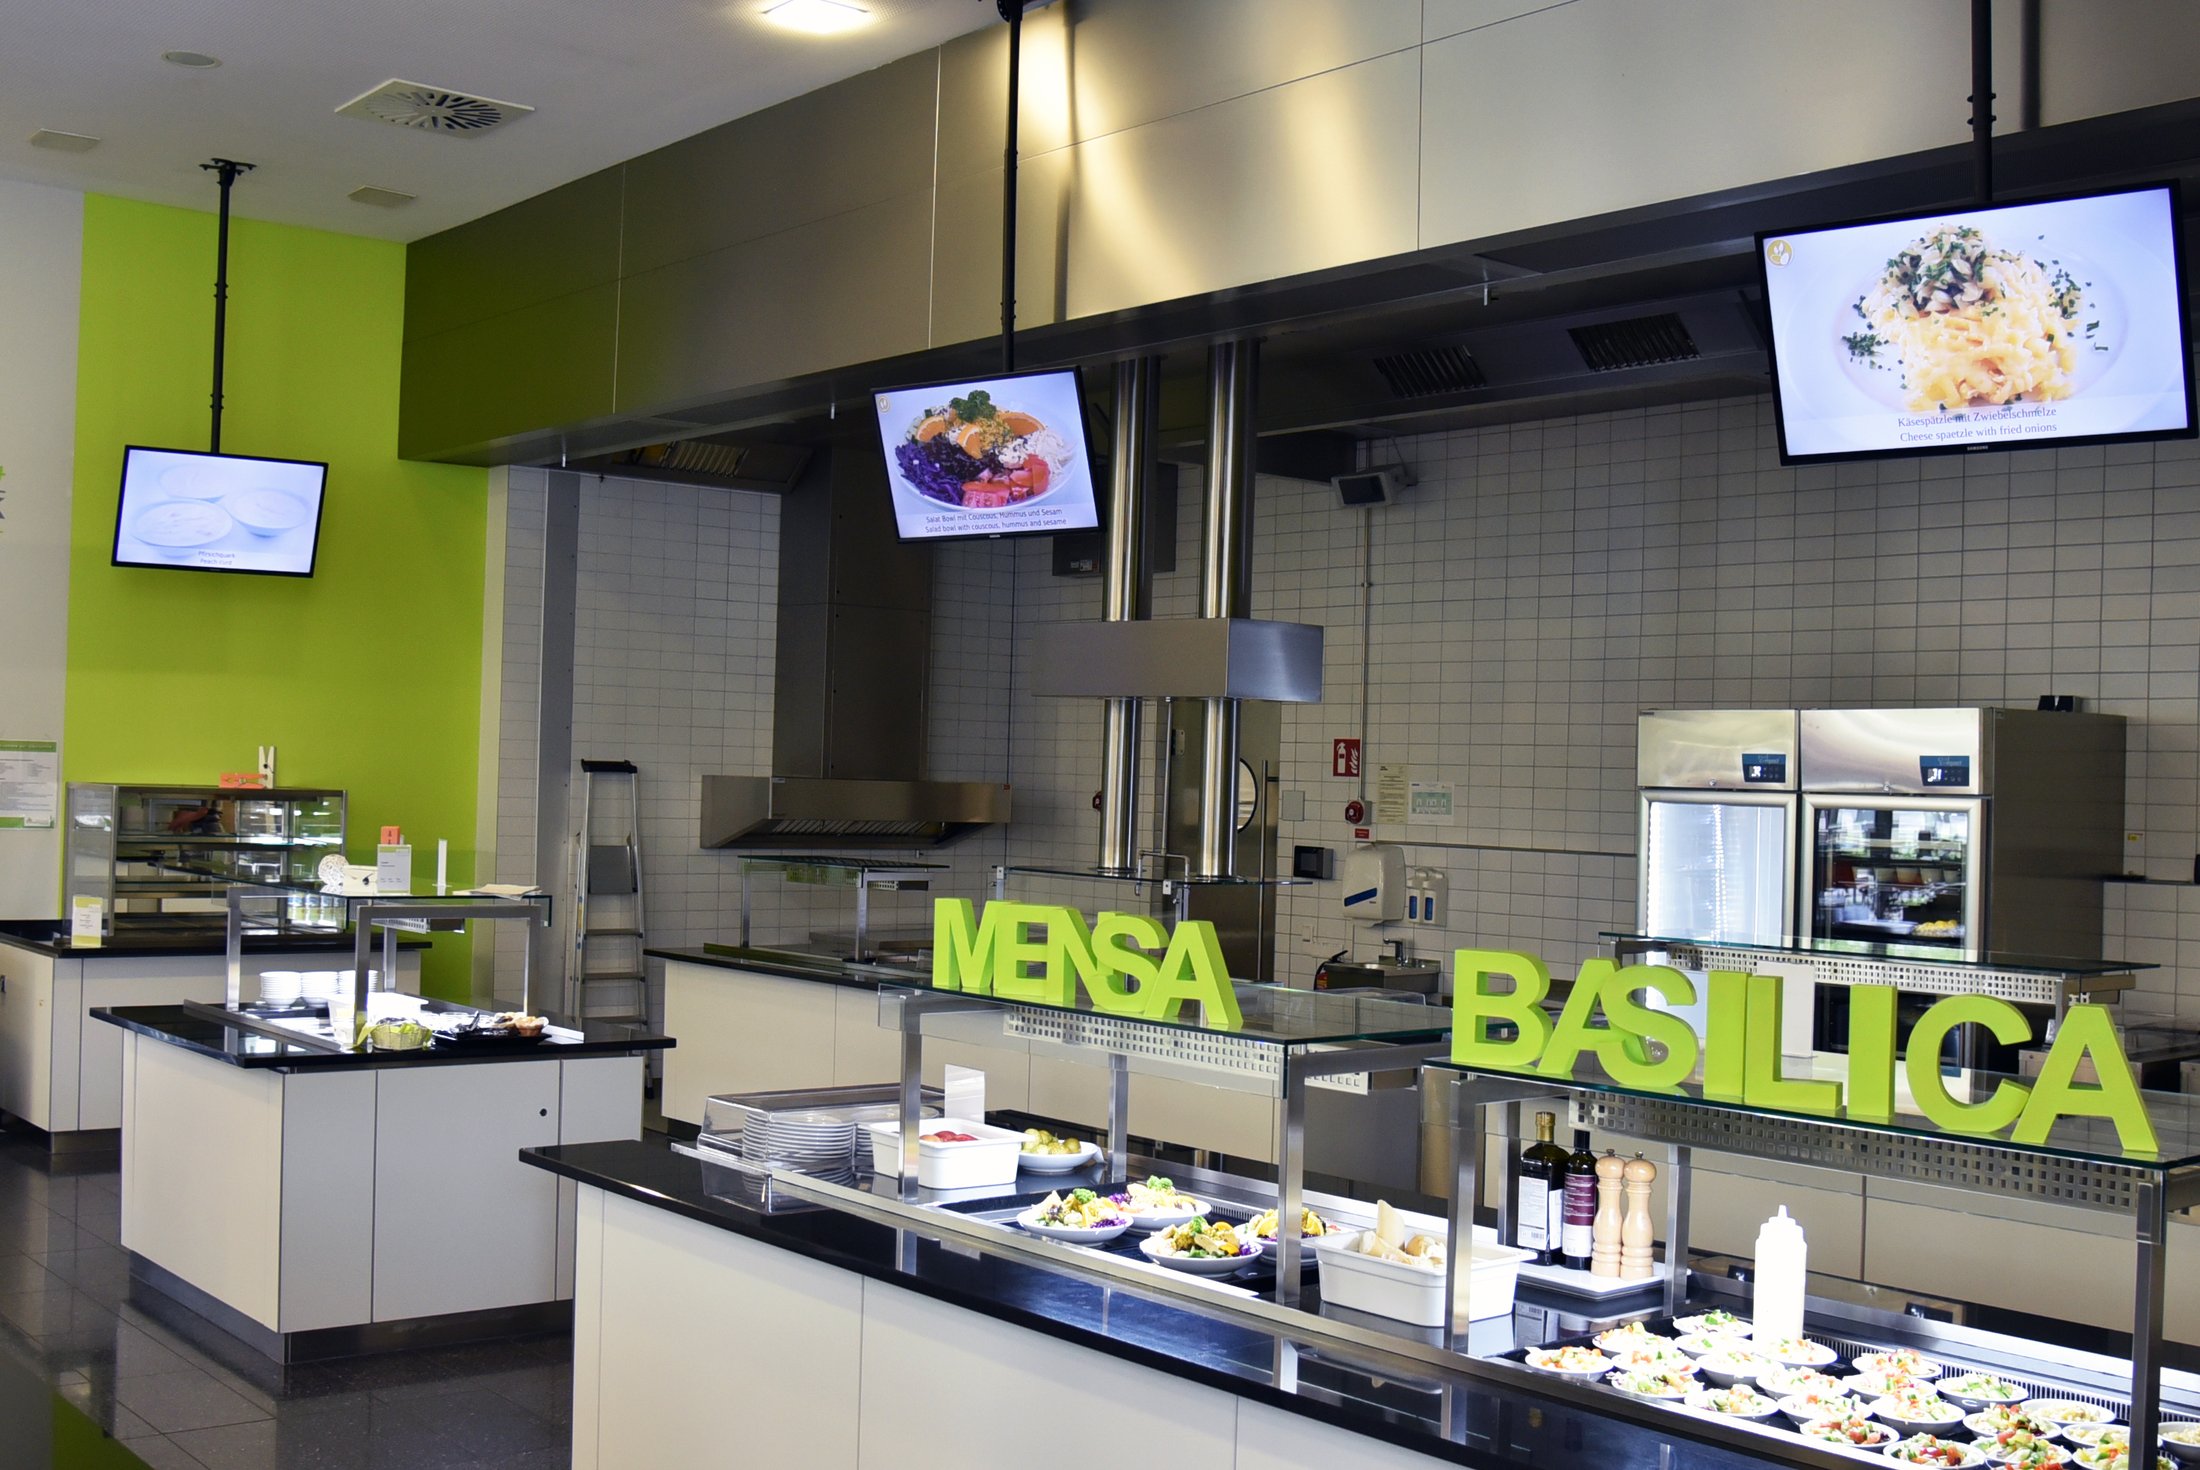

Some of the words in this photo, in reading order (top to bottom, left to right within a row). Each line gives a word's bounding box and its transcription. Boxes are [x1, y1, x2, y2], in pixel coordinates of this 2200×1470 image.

[1898, 414, 1951, 428] Käsespätzle
[1955, 413, 1971, 423] mit
[1973, 407, 2057, 422] Zwiebelschmelze
[1900, 432, 1934, 442] Cheese
[1936, 428, 1973, 442] spaetzle
[1976, 426, 1997, 437] with
[2000, 424, 2022, 436] fried
[2025, 423, 2057, 434] onions
[942, 514, 956, 522] Bowl
[1000, 511, 1027, 519] Hummus
[1028, 509, 1041, 517] und
[1041, 508, 1063, 516] Sesam
[925, 525, 942, 533] Salad
[943, 524, 956, 532] bowl
[957, 523, 970, 531] with
[1002, 521, 1029, 529] hummus
[1029, 519, 1042, 527] and
[1043, 518, 1067, 526] sesame
[932, 898, 1243, 1028] MENSA
[1451, 949, 2159, 1153] BASILICA
